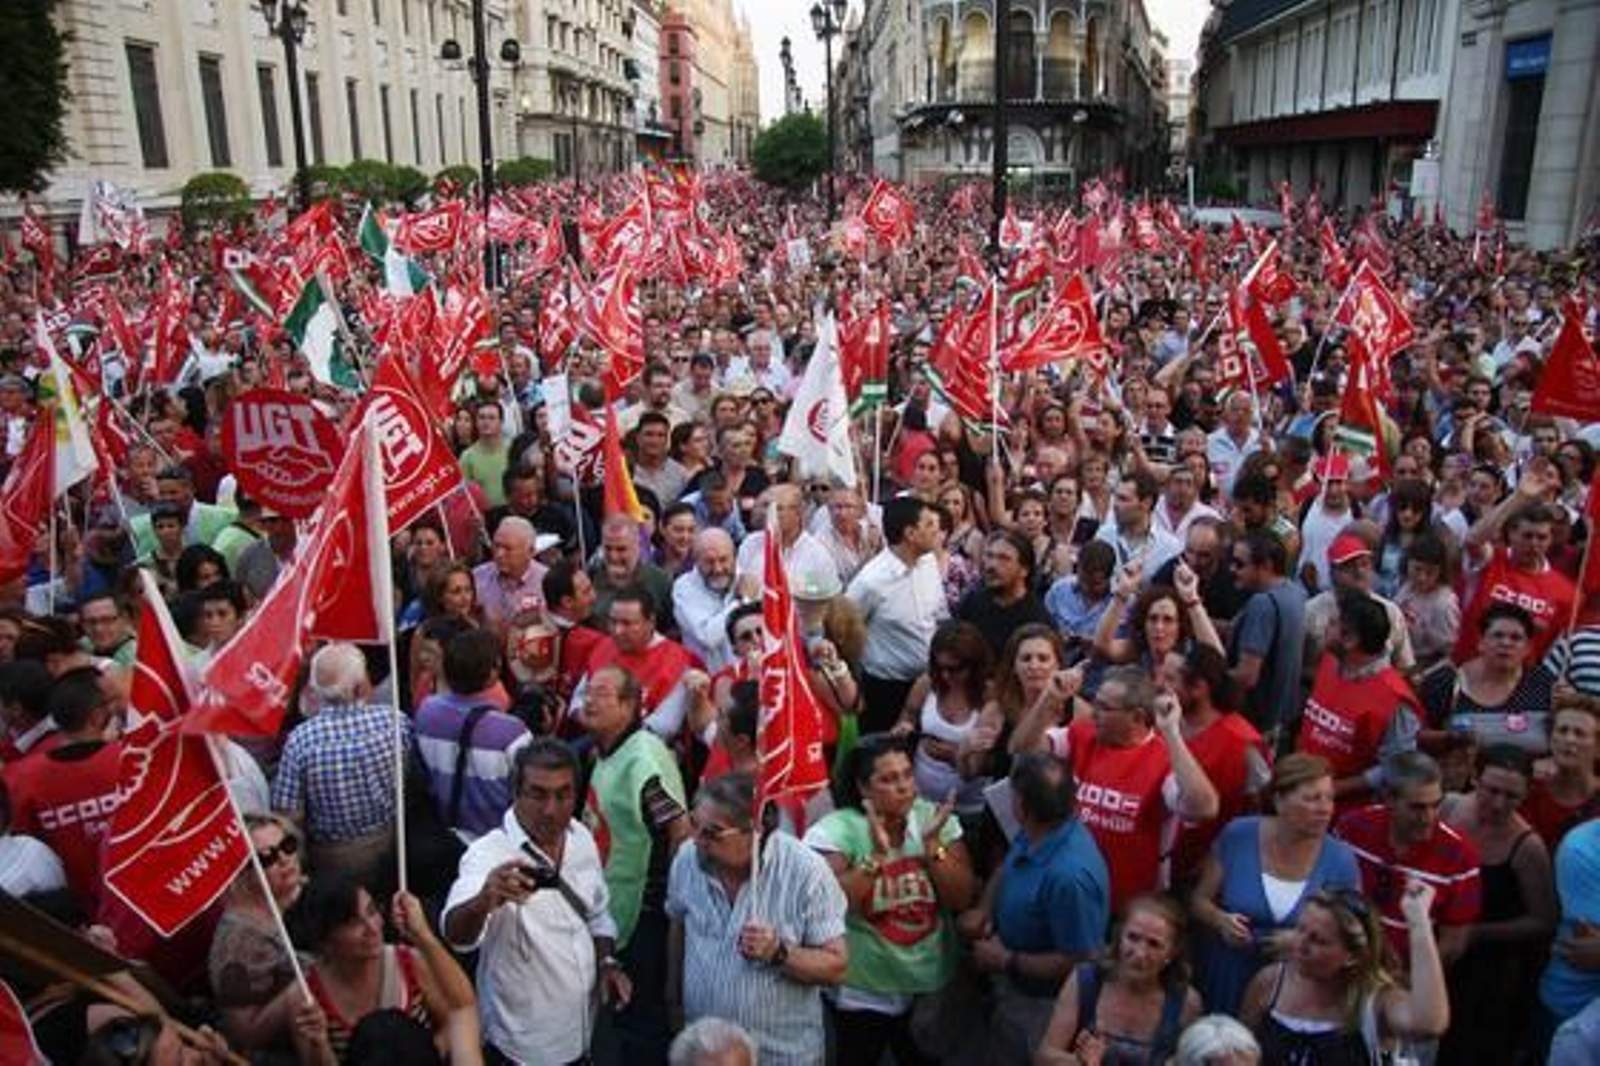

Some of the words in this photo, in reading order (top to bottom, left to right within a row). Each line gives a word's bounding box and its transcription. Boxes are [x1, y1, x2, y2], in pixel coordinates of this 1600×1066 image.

[233, 403, 320, 454] UGT
[367, 394, 424, 467] UGT
[872, 869, 937, 913] UGT
